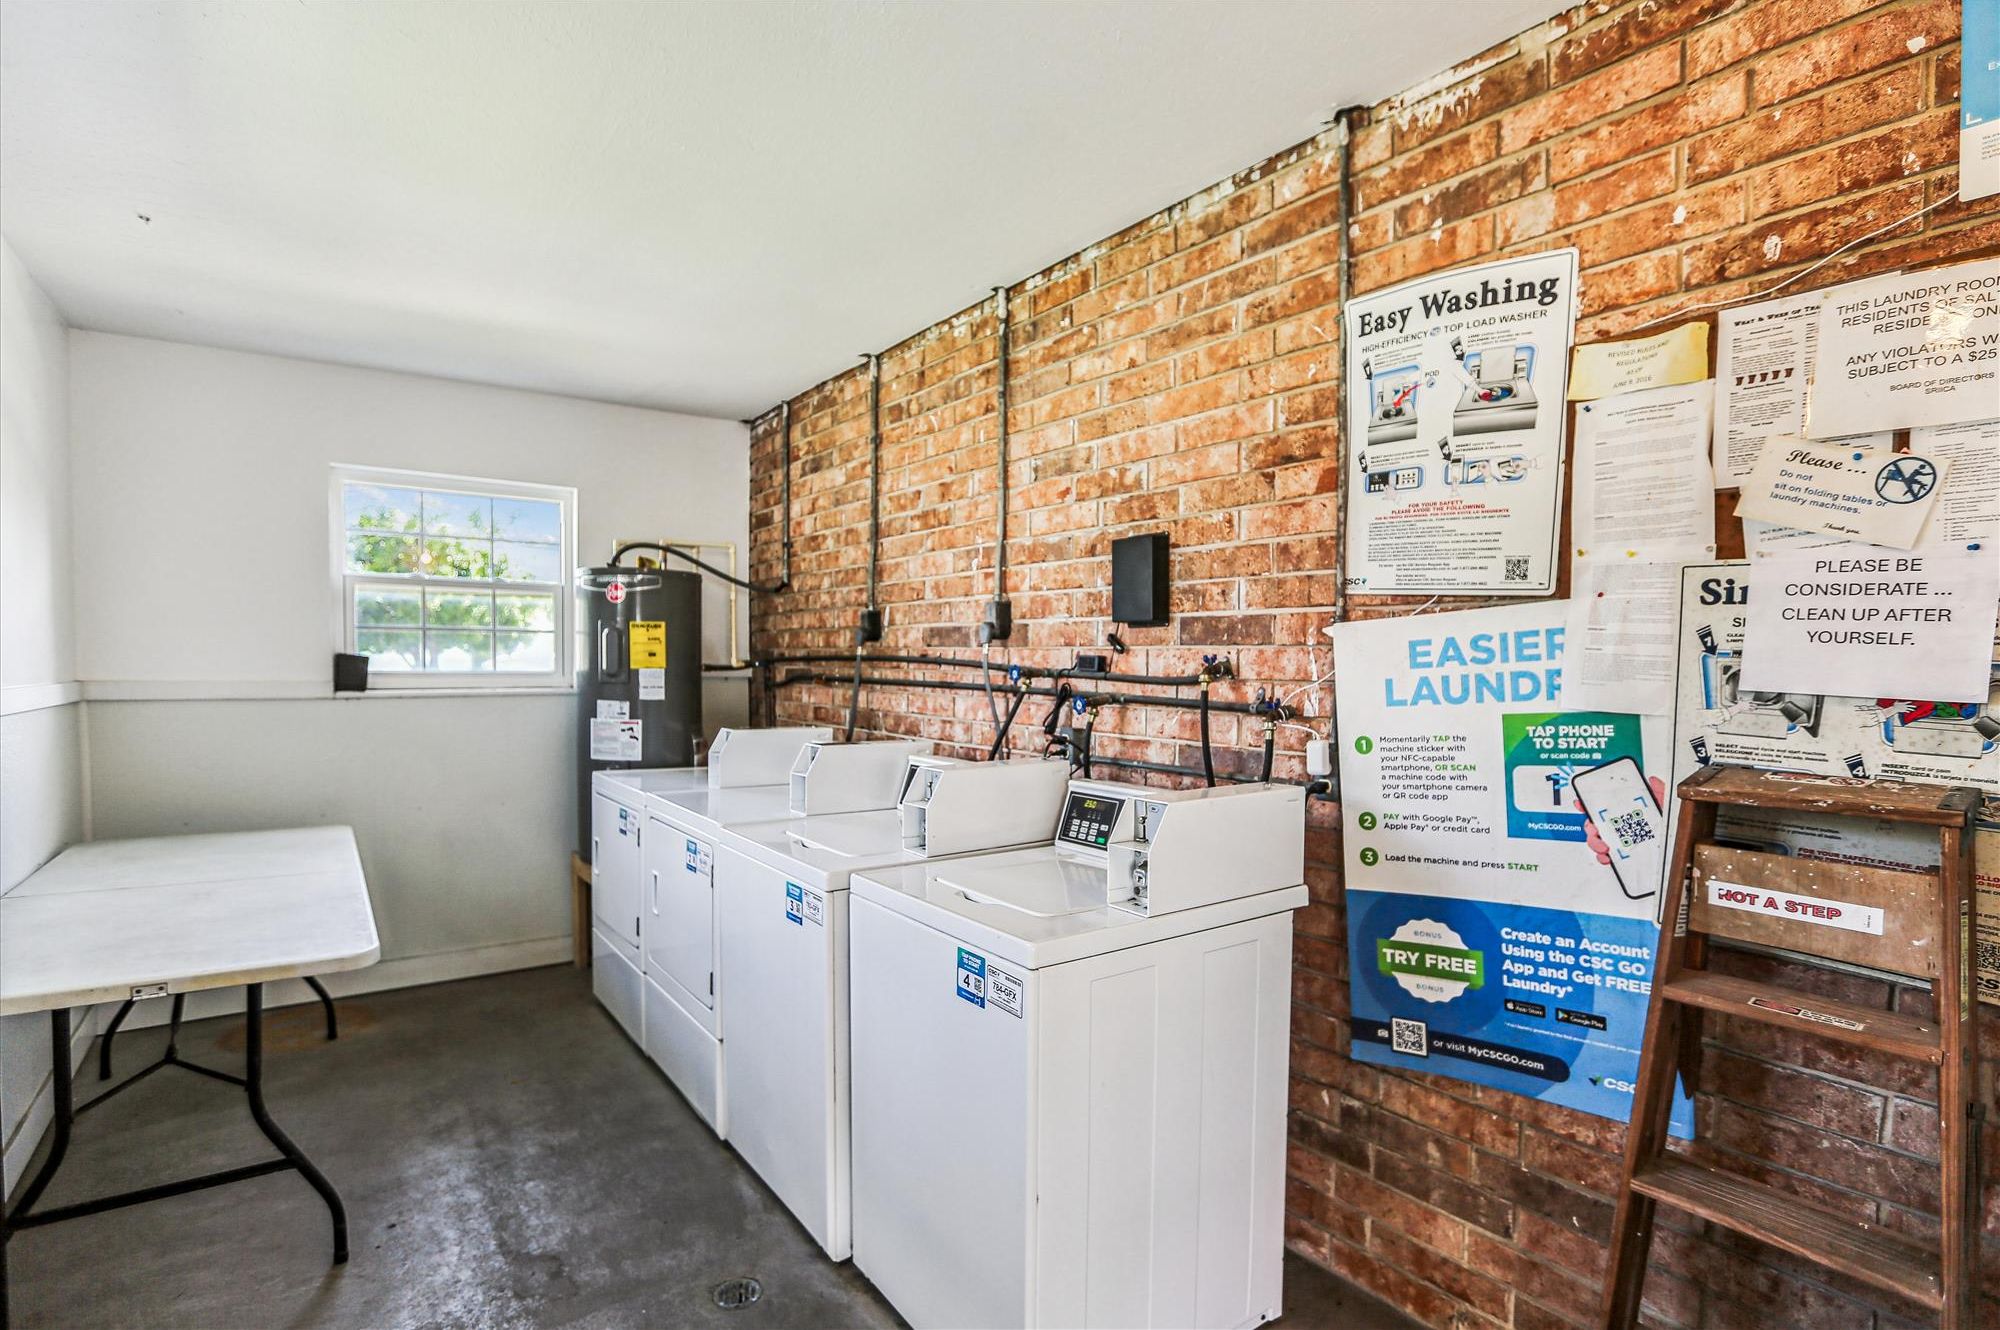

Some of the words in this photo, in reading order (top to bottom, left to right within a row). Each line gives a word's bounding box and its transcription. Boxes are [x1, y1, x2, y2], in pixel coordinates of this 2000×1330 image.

[1837, 300, 1869, 316] THIS
[1874, 284, 1951, 307] LAUNDRY
[1358, 306, 1413, 338] Easy
[1419, 277, 1560, 319] Washing
[1842, 302, 1930, 328] RESIDENTS
[1362, 331, 1428, 354] HIGH-EFFICIENCY
[1444, 322, 1463, 333] TOP
[1467, 317, 1496, 329] LOAD
[1500, 309, 1548, 323] WASHER
[1608, 349, 1637, 358] REVISED
[1846, 352, 1878, 366] ANY
[1848, 359, 1920, 379] SUBJECT
[1924, 356, 1946, 367] TO
[1951, 353, 1963, 364] A
[1968, 348, 1997, 362] $25
[1890, 381, 1922, 391] BOARD
[1924, 379, 1937, 387] OF
[1939, 372, 1995, 385] DIRECTORS
[1786, 449, 1843, 471] Please
[1780, 469, 1793, 478] Do
[1796, 473, 1813, 481] not
[1775, 482, 1788, 490] sit
[1804, 487, 1839, 501] folding
[1842, 494, 1873, 505] tables
[1770, 491, 1807, 505] laundry
[1809, 499, 1861, 514] machines.
[1823, 522, 1844, 533] Thank
[1815, 559, 1890, 573] PLEASE
[1896, 558, 1922, 572] BE
[1785, 582, 1928, 596] CONSIDERATE
[1782, 607, 1846, 621] CLEAN
[1852, 608, 1879, 621] UP
[1884, 608, 1951, 622] AFTER
[1806, 630, 1915, 646] YOURSELF.
[1526, 725, 1555, 737] TAP
[1558, 725, 1615, 736] PHONE
[1360, 740, 1367, 751] 1
[1416, 744, 1444, 752] sticker
[1447, 744, 1466, 752] with
[1533, 738, 1555, 749] TO
[1558, 737, 1609, 749] START
[1380, 755, 1398, 763] your
[1401, 754, 1455, 763] NFC-capable
[1697, 747, 1706, 757] 3
[1381, 764, 1433, 773] smartphone,
[1852, 766, 1865, 777] 4
[1881, 769, 1930, 778] INTRODUZCA
[1382, 783, 1400, 791] your
[1402, 784, 1453, 792] smartphone
[1545, 773, 1561, 806] 1
[1431, 794, 1448, 802] app
[1363, 815, 1372, 827] 2
[1422, 814, 1453, 823] Google
[1384, 822, 1408, 831] Apple
[1443, 825, 1468, 833] credit
[1471, 826, 1490, 834] card
[1364, 851, 1374, 863] 3
[1385, 853, 1406, 862] Load
[1408, 855, 1421, 863] the
[1424, 856, 1459, 866] machine
[1462, 859, 1479, 867] and
[1481, 861, 1505, 869] press
[1507, 863, 1539, 872] START
[1842, 853, 1875, 863] SAFETY
[1878, 859, 1913, 869] PLEASE
[1718, 888, 1759, 905] NOT
[1763, 897, 1778, 909] A
[1785, 900, 1842, 920] STEP
[1413, 930, 1442, 939] BONUS
[1500, 927, 1551, 945] Create
[1555, 936, 1575, 948] an
[1578, 938, 1650, 959] Account
[1382, 948, 1419, 966] TRY
[1424, 953, 1477, 975] FREE
[1501, 943, 1544, 962] Using
[1548, 950, 1575, 965] the
[1579, 955, 1614, 971] CSC
[1617, 961, 1646, 976] GO
[963, 974, 970, 988] 4
[1502, 959, 1534, 975] App
[1538, 966, 1568, 980] and
[1571, 970, 1602, 986] Get
[1605, 975, 1651, 995] FREE
[1416, 983, 1444, 993] BONUS
[1569, 1016, 1591, 1026] Google
[1446, 1041, 1466, 1052] visit
[1468, 1045, 1544, 1070] MyCSCGO.com
